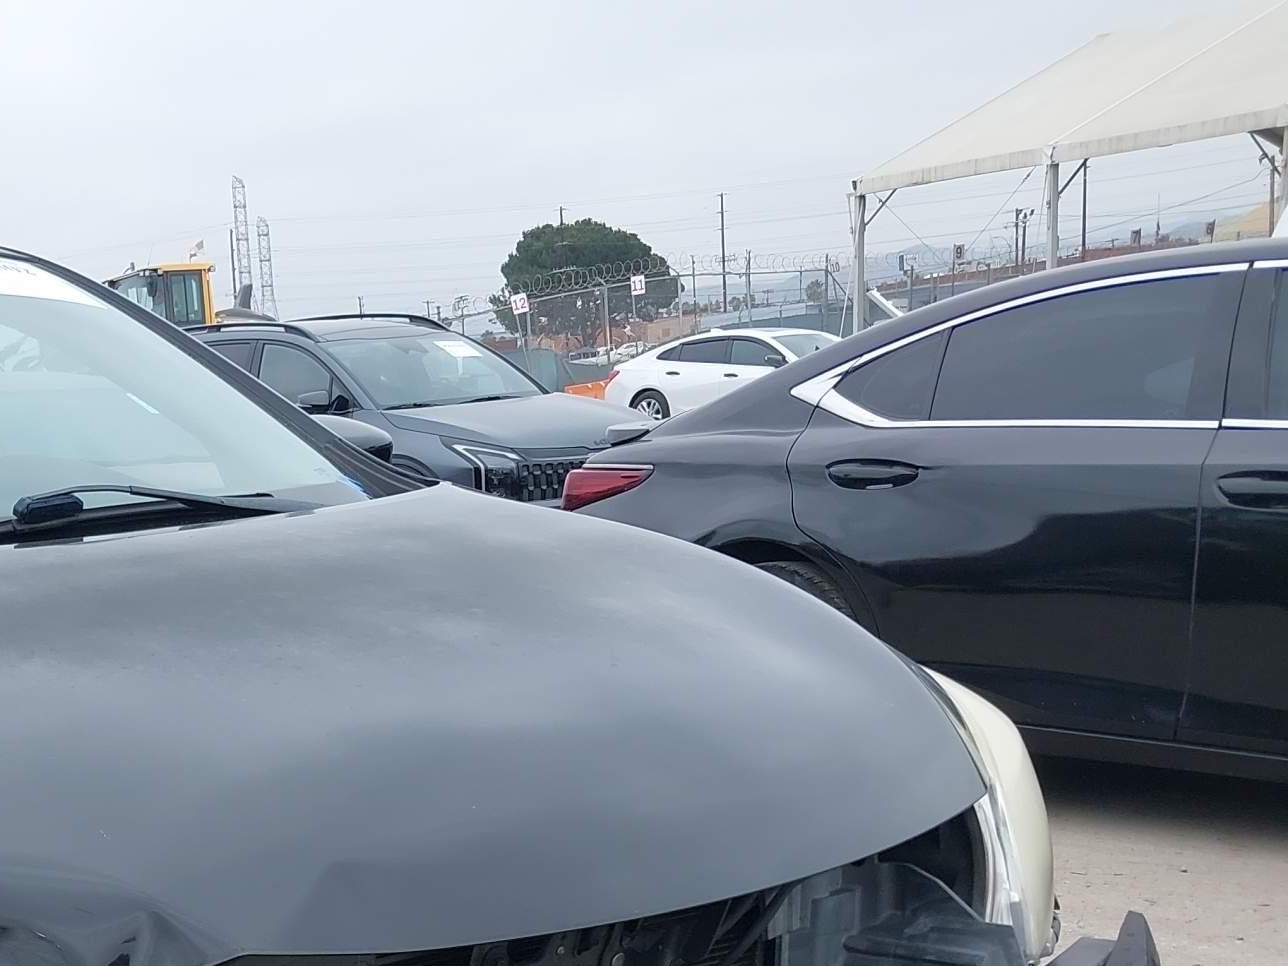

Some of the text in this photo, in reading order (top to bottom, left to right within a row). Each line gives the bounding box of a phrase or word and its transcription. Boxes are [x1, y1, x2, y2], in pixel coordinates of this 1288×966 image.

[955, 246, 962, 259] 9
[830, 262, 840, 273] 10
[631, 278, 645, 292] 11
[513, 297, 527, 311] 12
